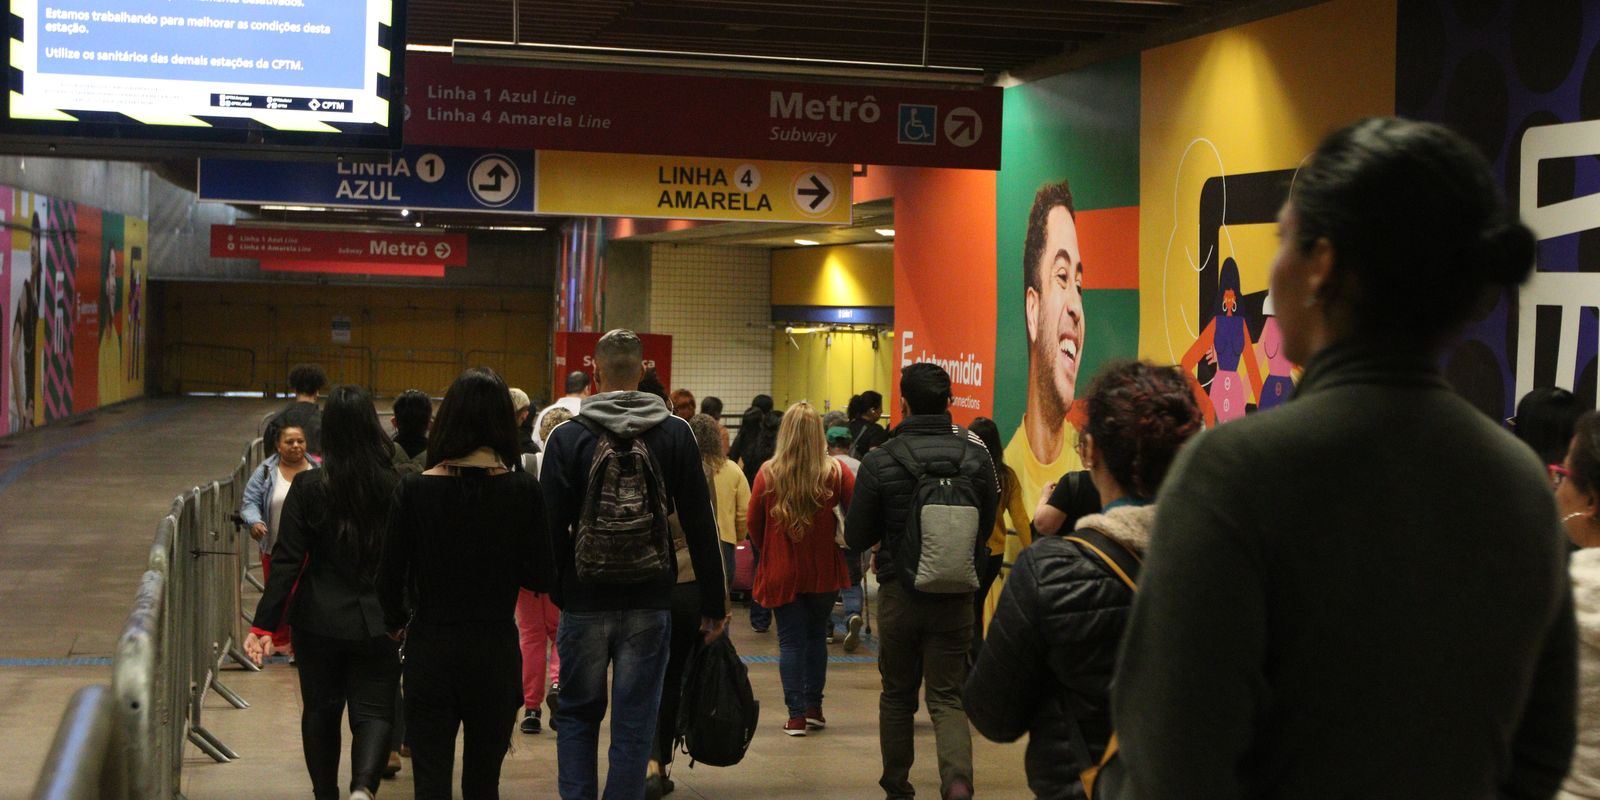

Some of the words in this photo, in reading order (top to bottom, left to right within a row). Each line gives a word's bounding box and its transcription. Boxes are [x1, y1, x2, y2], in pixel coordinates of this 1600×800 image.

[45, 8, 90, 21] Estamos
[91, 11, 158, 25] trabalhando
[160, 16, 185, 27] para
[187, 17, 236, 29] melhorar
[237, 20, 249, 29] as
[250, 21, 302, 34] condições
[303, 23, 332, 35] desta
[45, 22, 89, 35] estação.
[45, 47, 81, 60] Utilize
[82, 50, 95, 60] os
[96, 50, 148, 63] sanitários
[150, 53, 169, 65] das
[171, 55, 209, 66] demais
[209, 58, 254, 70] estações
[255, 58, 270, 69] da
[271, 59, 305, 71] CPTM.
[321, 101, 345, 110] CPTM
[428, 85, 477, 101] Linha
[484, 88, 492, 102] 1
[499, 89, 538, 105] Azul
[543, 90, 577, 106] Line
[427, 107, 476, 122] Linha
[482, 110, 492, 124] 4
[498, 111, 574, 128] Amarela
[578, 113, 612, 129] Line
[769, 91, 881, 124] Metrô
[769, 126, 838, 148] Subway
[336, 156, 412, 178] LINHA
[424, 159, 436, 178] 1
[658, 165, 730, 187] LINHA
[740, 168, 754, 188] 4
[335, 180, 402, 202] AZUL
[657, 189, 774, 213] AMARELA
[369, 240, 429, 258] Metrô
[915, 350, 983, 388] omidia
[950, 394, 982, 411] onnections
